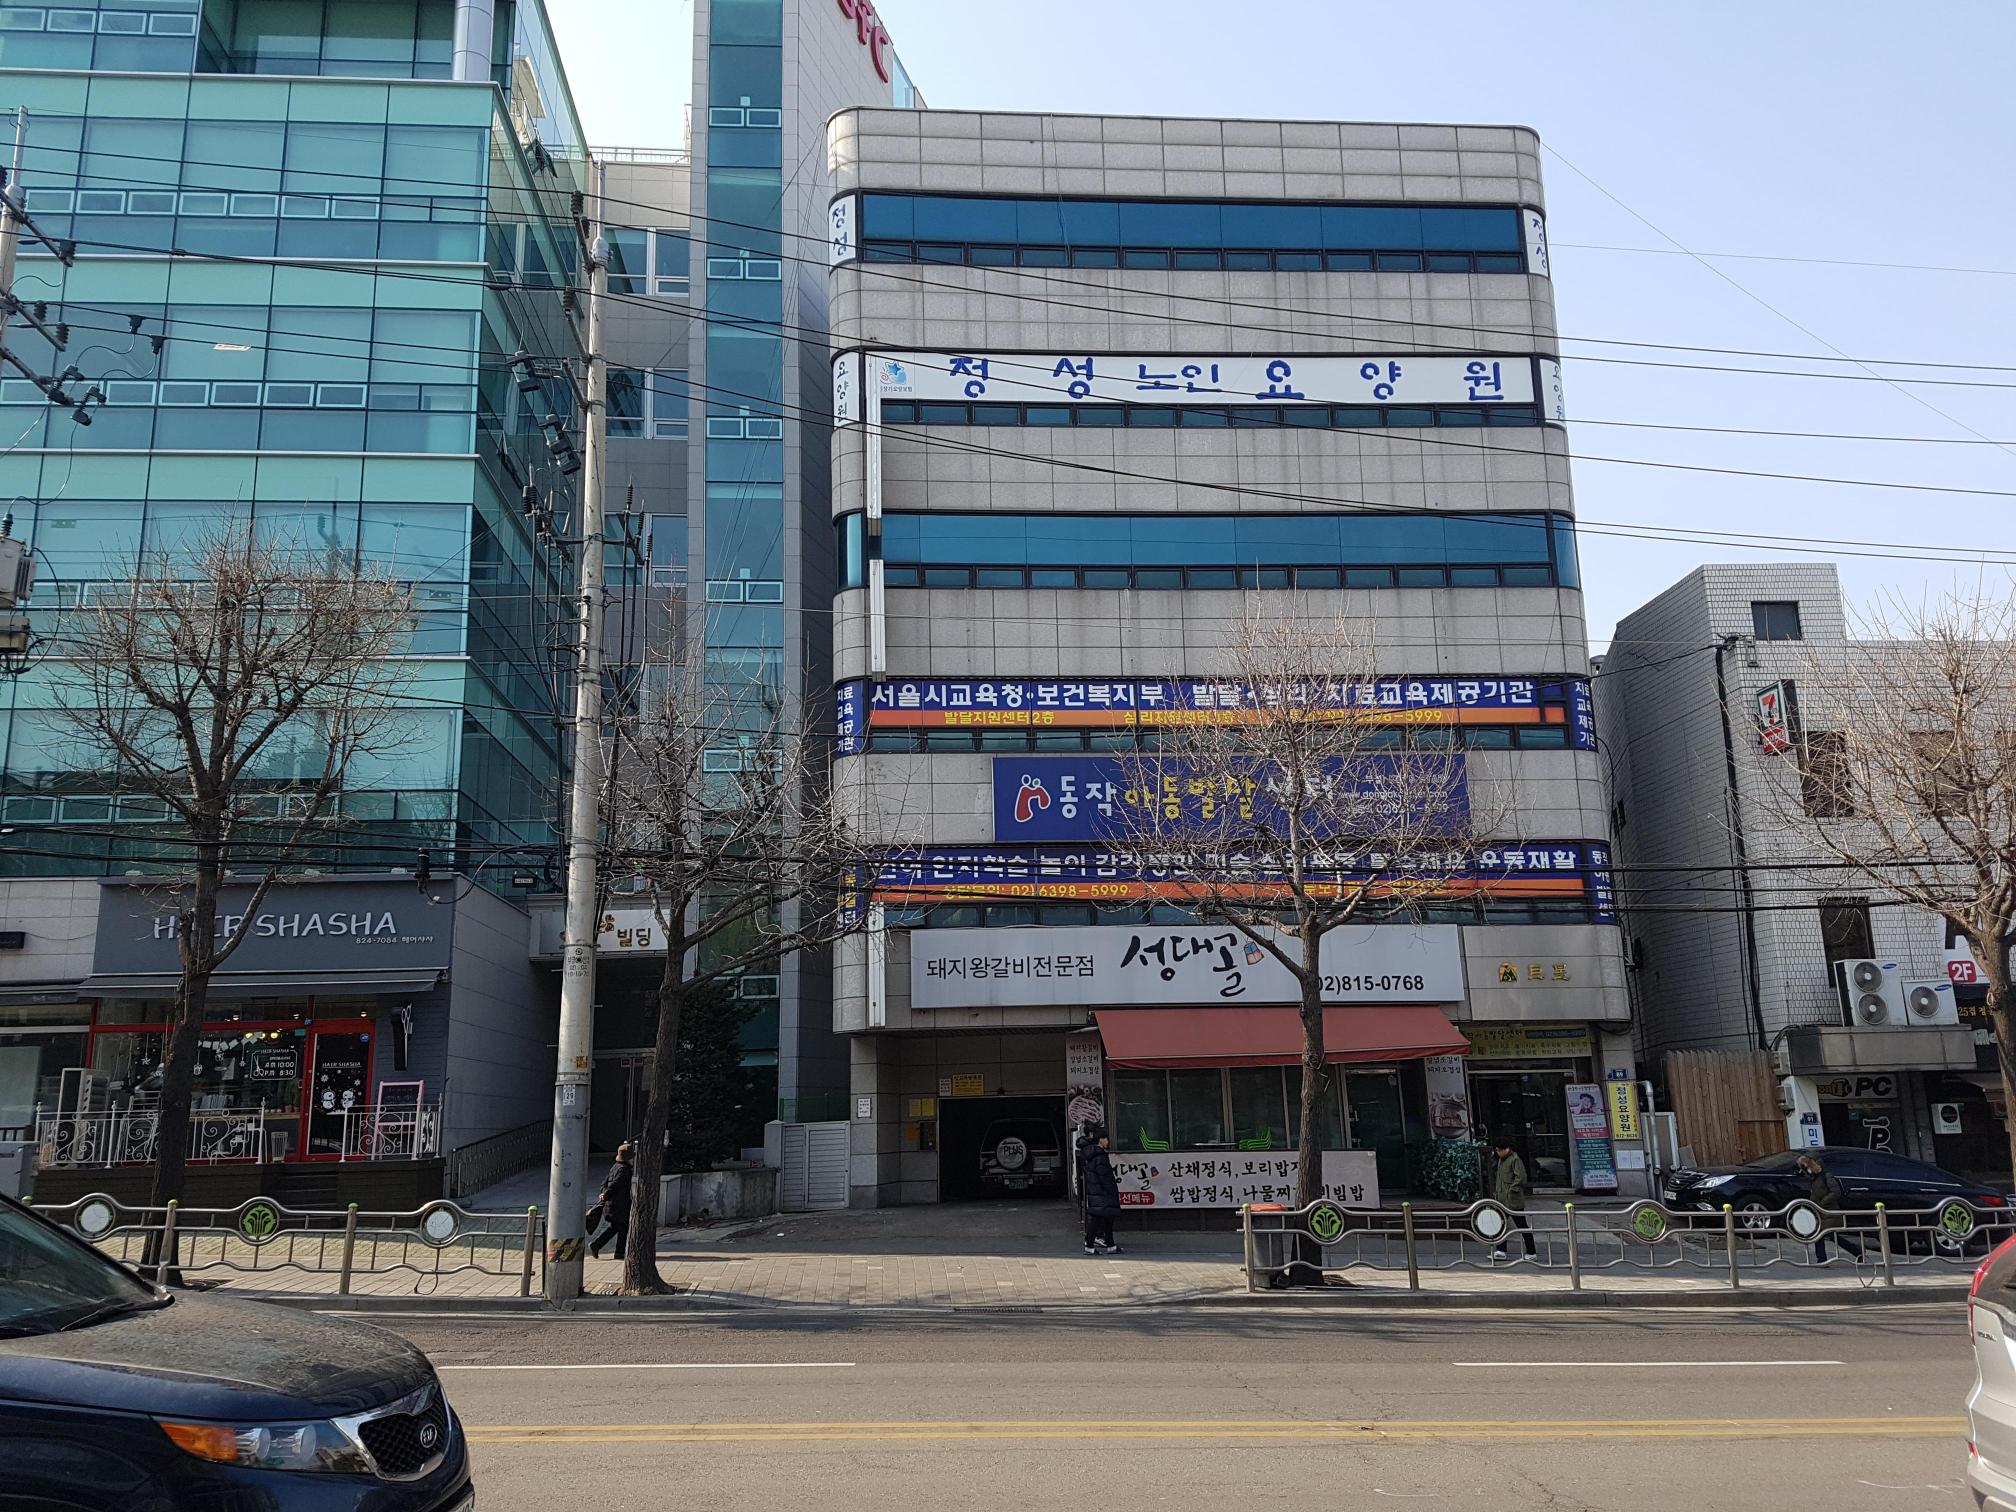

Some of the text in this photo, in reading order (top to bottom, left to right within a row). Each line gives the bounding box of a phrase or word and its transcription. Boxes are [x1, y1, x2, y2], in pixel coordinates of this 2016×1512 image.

[832, 204, 848, 256] 정성
[1039, 885, 1130, 898] 6398-5999
[154, 911, 398, 939] HIR SHASHA
[617, 928, 651, 946] 빌딩
[926, 954, 1095, 980] 돼지왕갈비전문점
[1952, 963, 1973, 980] 2F
[1855, 1076, 1892, 1096] PC
[1120, 1193, 1151, 1204] 선메뉴
